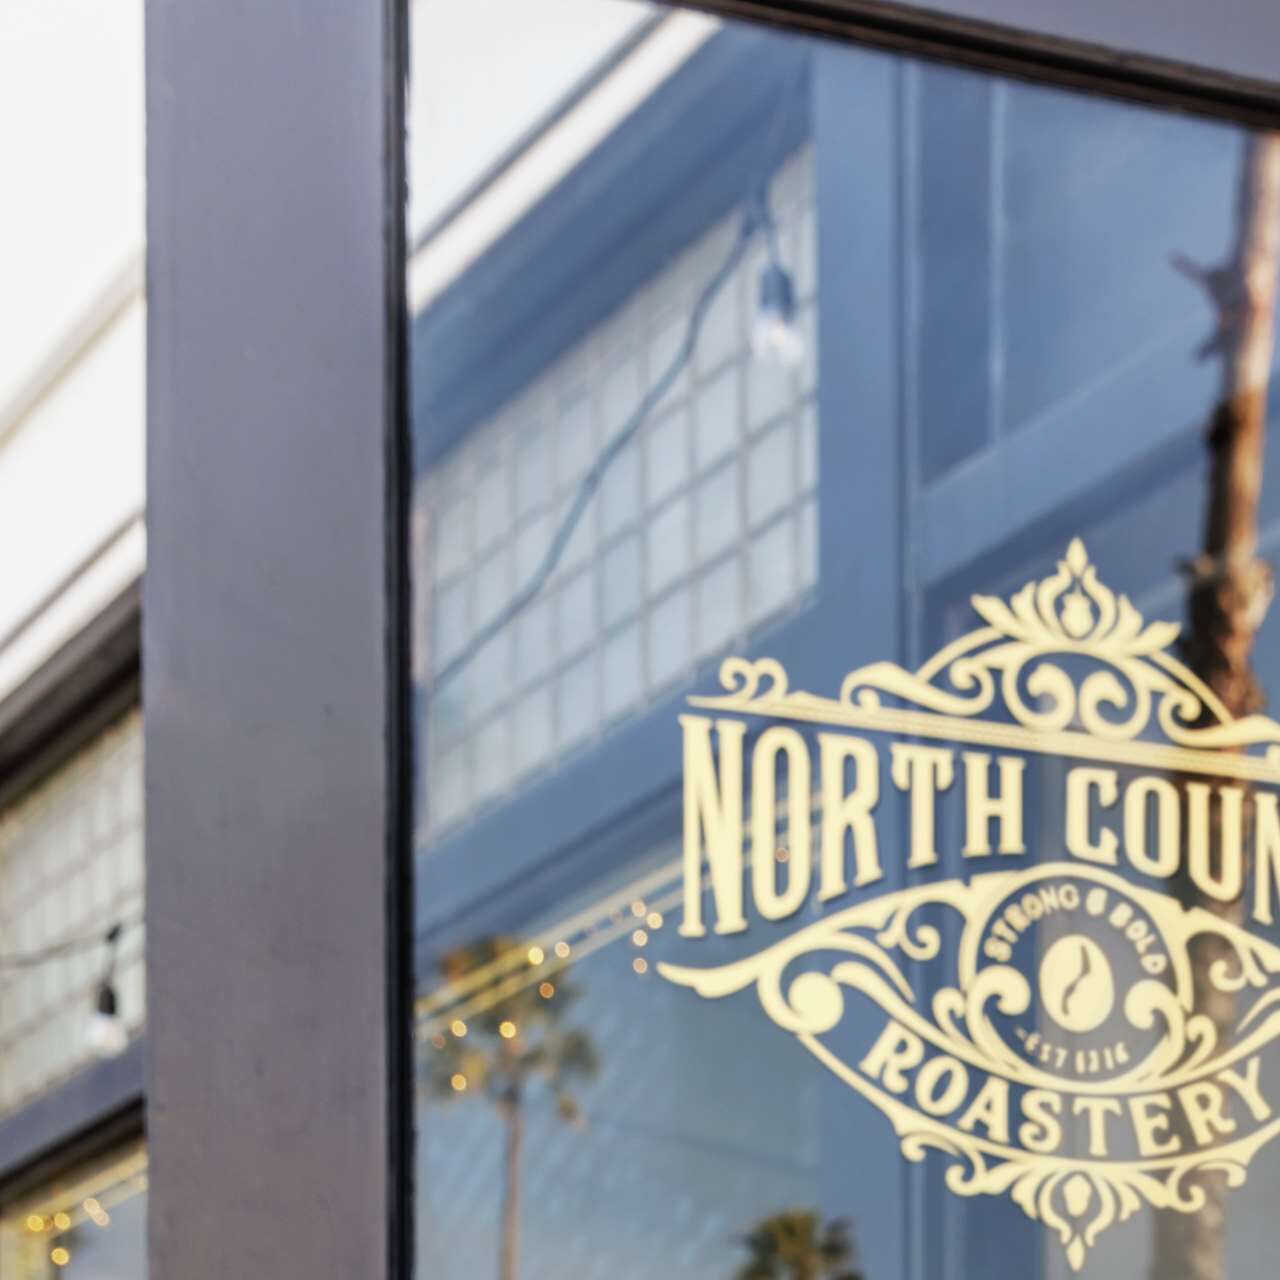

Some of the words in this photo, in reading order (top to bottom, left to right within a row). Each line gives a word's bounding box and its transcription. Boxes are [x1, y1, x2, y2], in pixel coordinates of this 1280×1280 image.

[678, 713, 1027, 938] NORTH
[983, 883, 1080, 962] STRONG
[1108, 902, 1167, 976] BOLD
[858, 1020, 1271, 1157] ROASTERY
